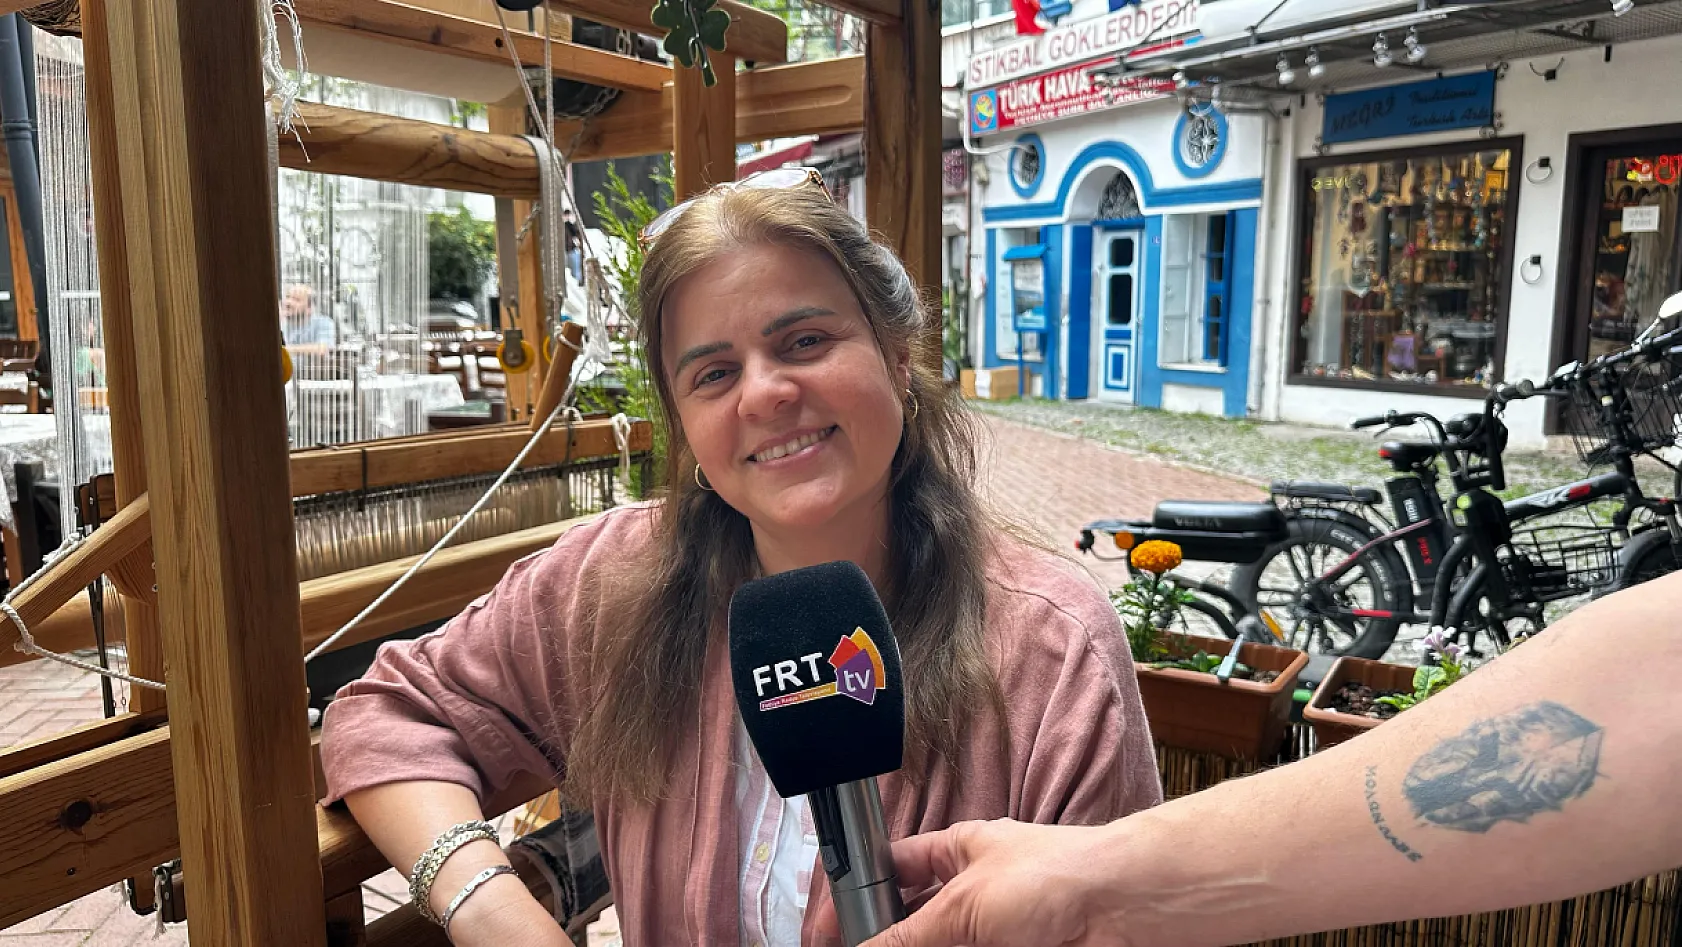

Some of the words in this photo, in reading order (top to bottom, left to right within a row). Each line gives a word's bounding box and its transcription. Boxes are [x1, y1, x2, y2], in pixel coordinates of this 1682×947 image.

[999, 80, 1041, 113] TÜRK
[1044, 68, 1091, 101] HAVA
[752, 652, 822, 696] FRT
[843, 669, 870, 692] tv
